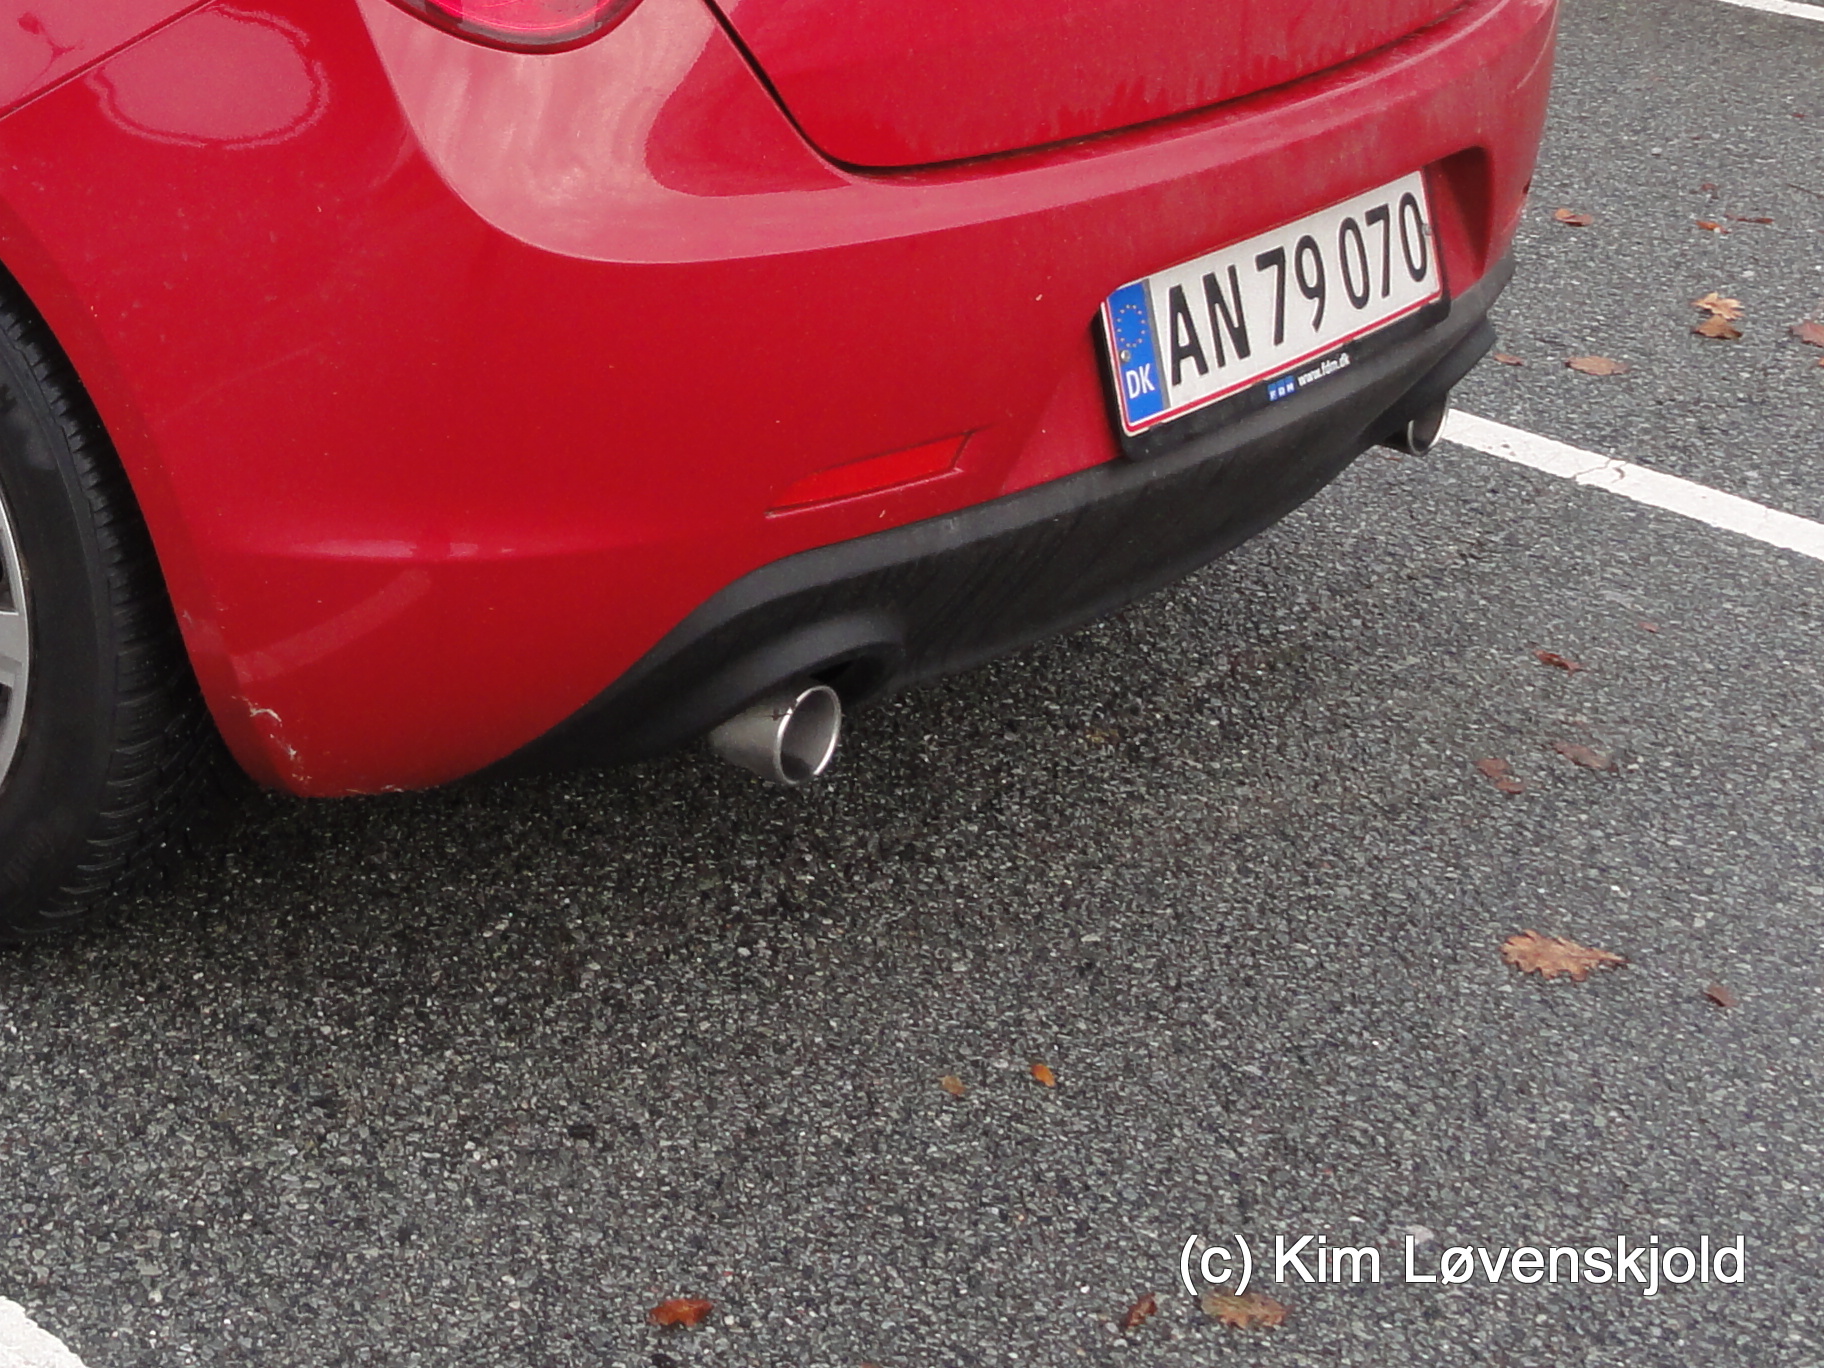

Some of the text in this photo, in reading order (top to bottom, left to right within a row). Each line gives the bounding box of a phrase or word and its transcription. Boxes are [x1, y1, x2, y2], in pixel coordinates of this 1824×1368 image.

[1168, 192, 1427, 386] AN 79 070
[1126, 363, 1155, 400] DK
